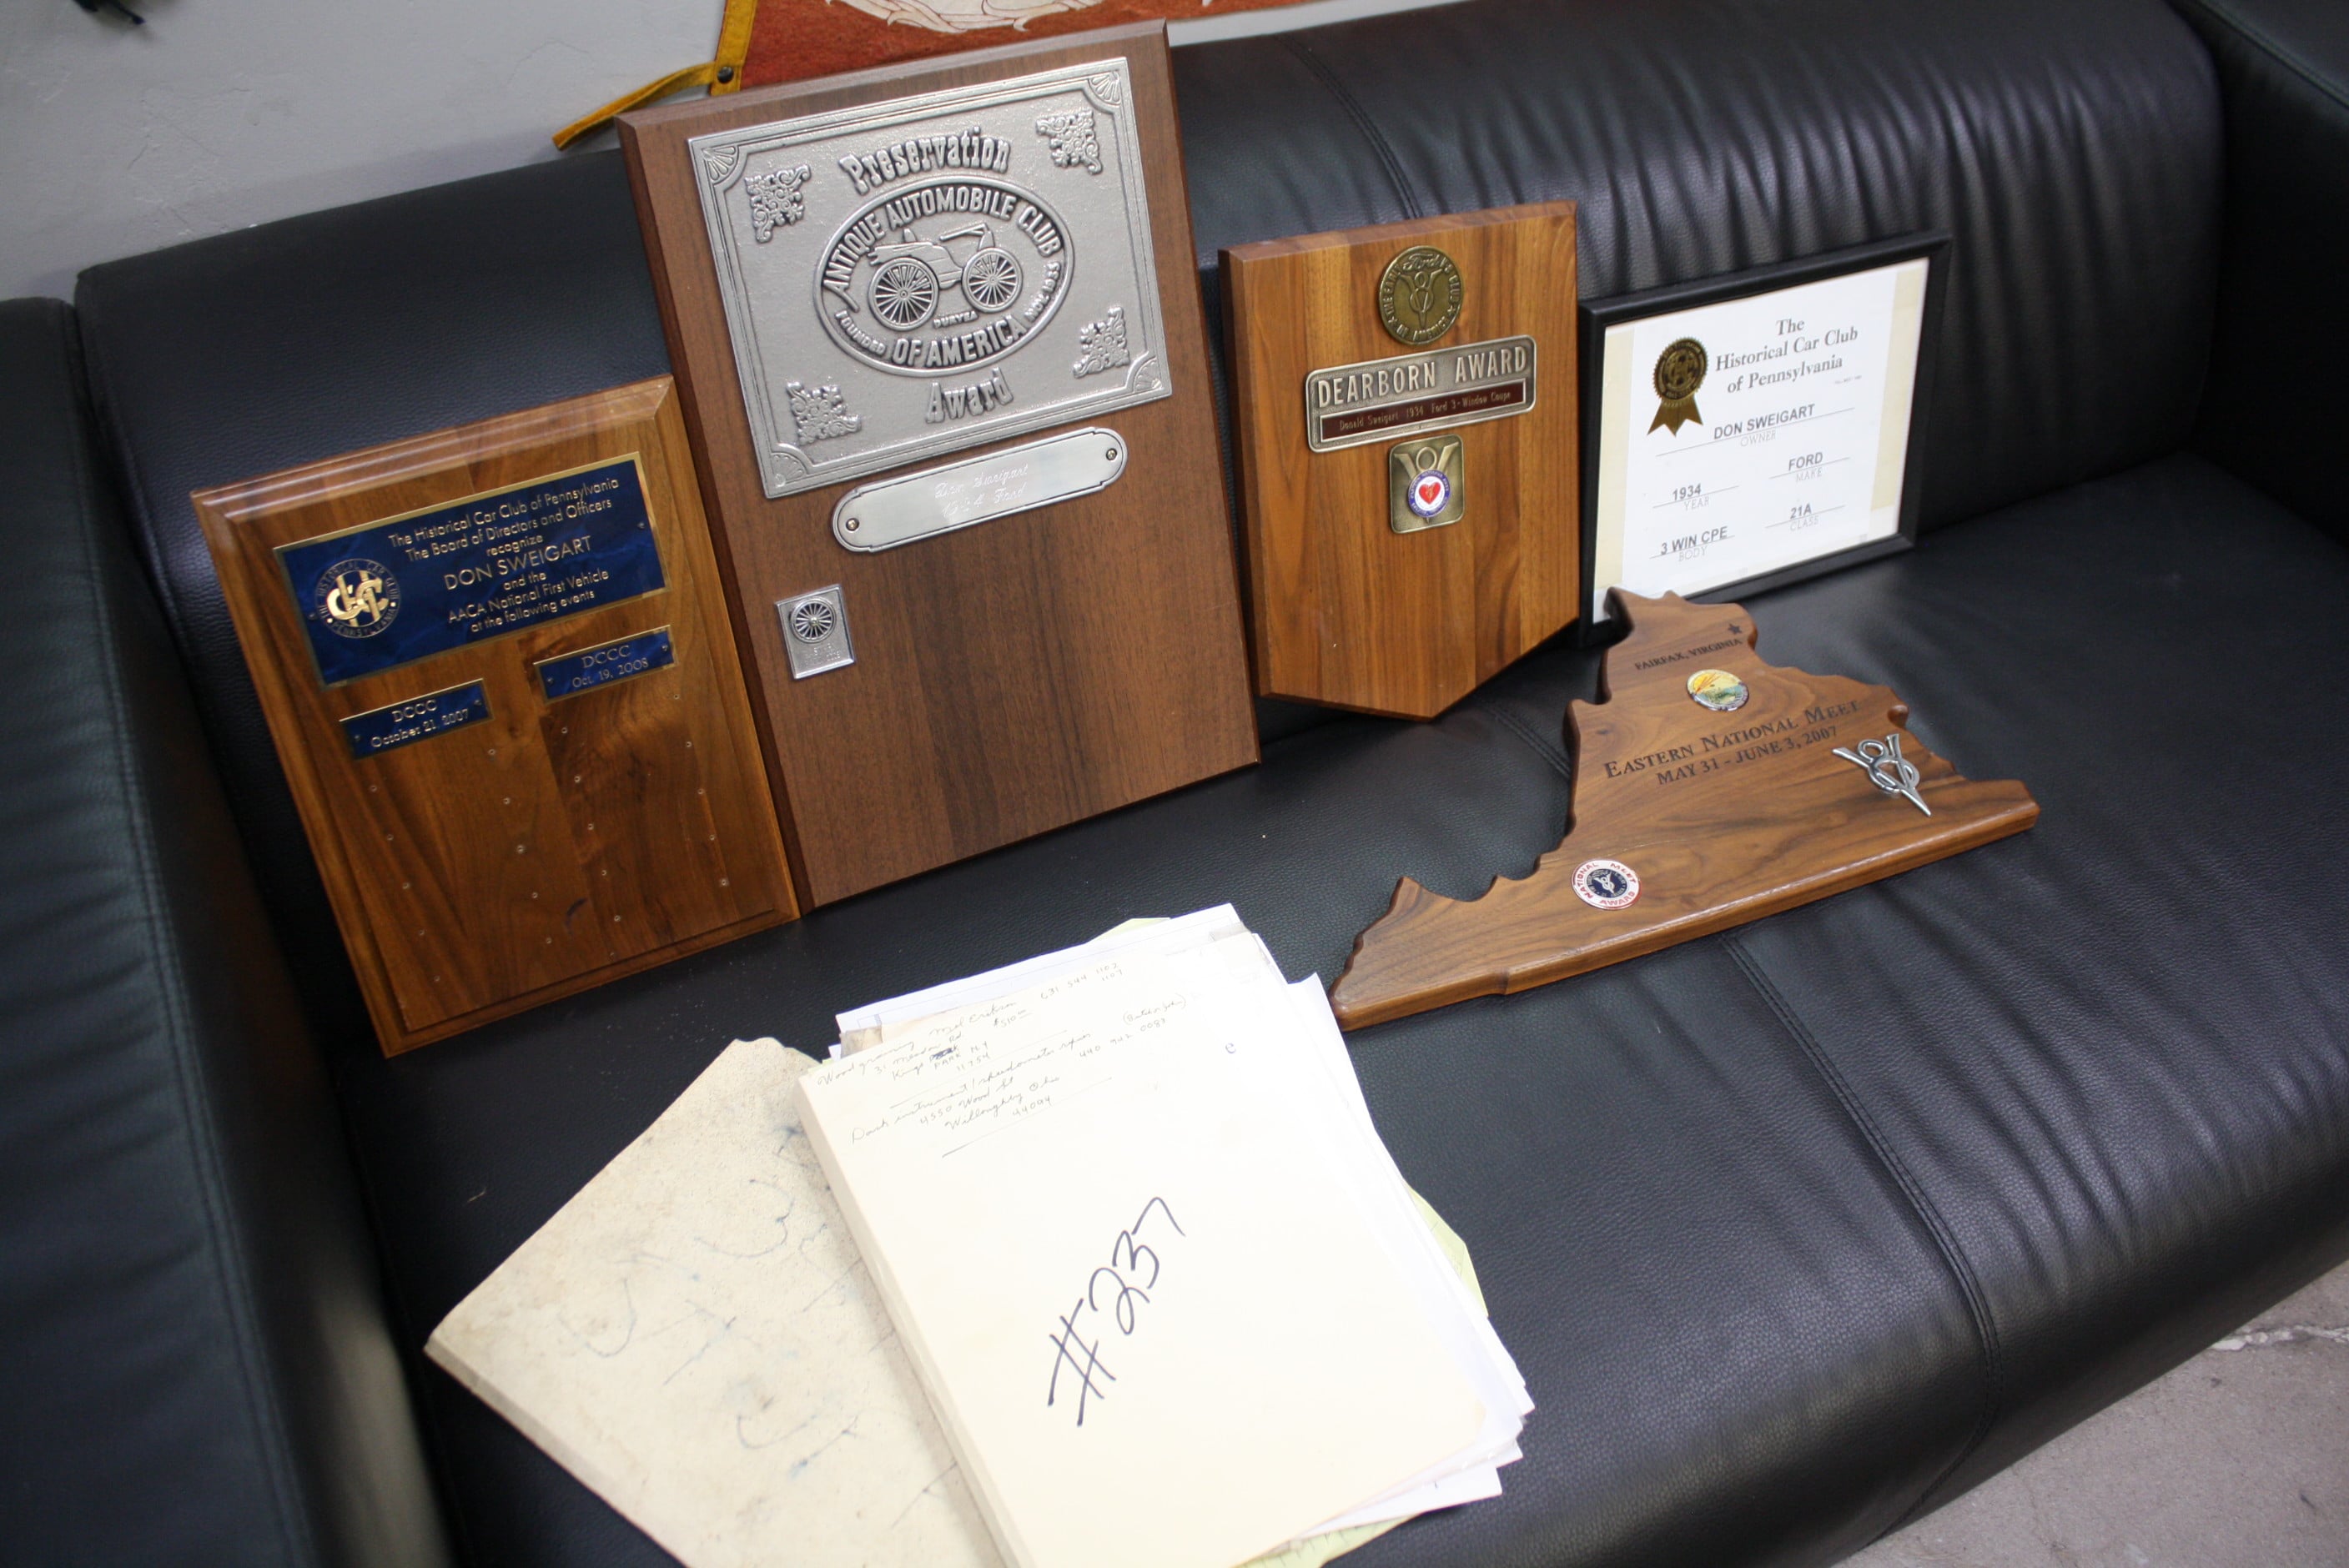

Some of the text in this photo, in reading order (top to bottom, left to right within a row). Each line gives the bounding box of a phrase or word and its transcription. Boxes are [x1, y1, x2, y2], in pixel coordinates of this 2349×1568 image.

[838, 125, 1012, 195] Preservation
[823, 186, 1064, 314] ANTIQUE AUTOMOBILE CLUB
[834, 309, 887, 355] FOUNDED
[932, 310, 979, 329] DURYEA
[1776, 317, 1805, 336] The
[893, 314, 1026, 368] OF AMERICA
[1715, 325, 1859, 372] Historical Car Club
[1317, 345, 1527, 409] DEARBORN AWARD
[1727, 375, 1744, 395] of
[1748, 354, 1843, 389] Pennsylvania
[925, 367, 1015, 424] Award
[1431, 400, 1448, 414] Ford
[1713, 404, 1816, 440] DON SWEIGART
[1740, 430, 1777, 448] OWNER
[1788, 451, 1824, 471] FORD
[1795, 467, 1823, 482] MAKE
[1672, 483, 1703, 500] 1934
[1683, 496, 1710, 512] YEAR
[388, 478, 620, 548] The Historical Car Club of Pennsylvania
[1789, 503, 1813, 520] 21A
[1789, 515, 1819, 532] CLASS
[405, 497, 613, 562] The Board of Directors and Officers
[485, 533, 545, 557] recognize
[1660, 526, 1728, 555] 3 WIN CPE
[443, 535, 592, 591] DON SWEIGART
[1677, 545, 1708, 562] BODY
[448, 567, 611, 624] AACA National First Vehicle
[503, 570, 547, 591] and the
[470, 589, 596, 634] at the following events
[582, 644, 631, 670] DCCC
[616, 656, 651, 675] 2008
[1635, 637, 1743, 671] FAIRFAX, VIRGINIA
[370, 724, 421, 750] October
[442, 706, 470, 726] 2007
[391, 699, 439, 724] DCCC
[1603, 699, 1861, 779] EASTERN NATIONAL MEET
[1656, 761, 1698, 786] MAY
[1702, 756, 1721, 773] 31
[1735, 740, 1783, 765] JUNE
[1786, 736, 1802, 751] 3,
[1804, 726, 1838, 746] 2007
[1576, 862, 1599, 899] NATIONAL
[1610, 862, 1637, 883] MEET
[1599, 891, 1636, 906] AWARD
[1047, 1196, 1187, 1428] #237
